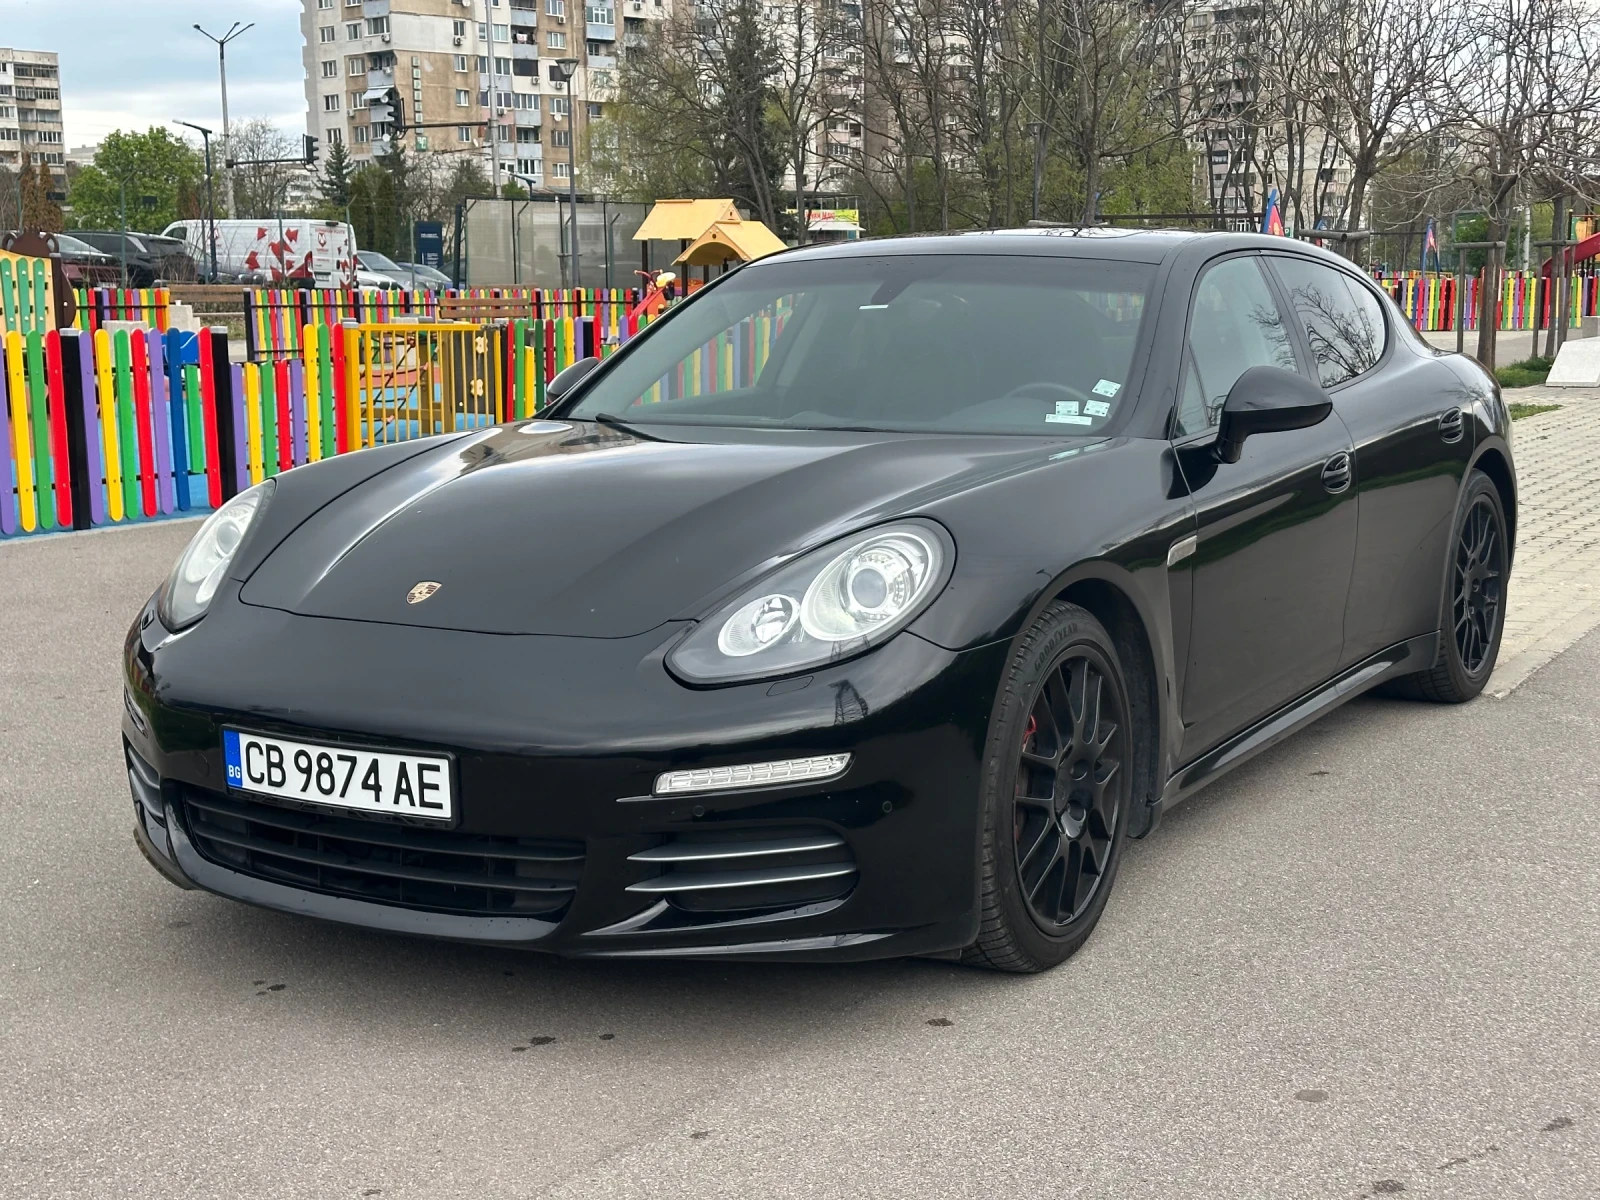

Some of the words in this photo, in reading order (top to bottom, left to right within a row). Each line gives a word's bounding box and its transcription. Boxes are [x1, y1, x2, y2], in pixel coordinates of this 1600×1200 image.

[1035, 623, 1078, 671] GOODYEAR
[228, 764, 241, 779] BG
[245, 741, 286, 787] CB
[294, 749, 382, 802] 9874
[393, 761, 443, 809] AE
